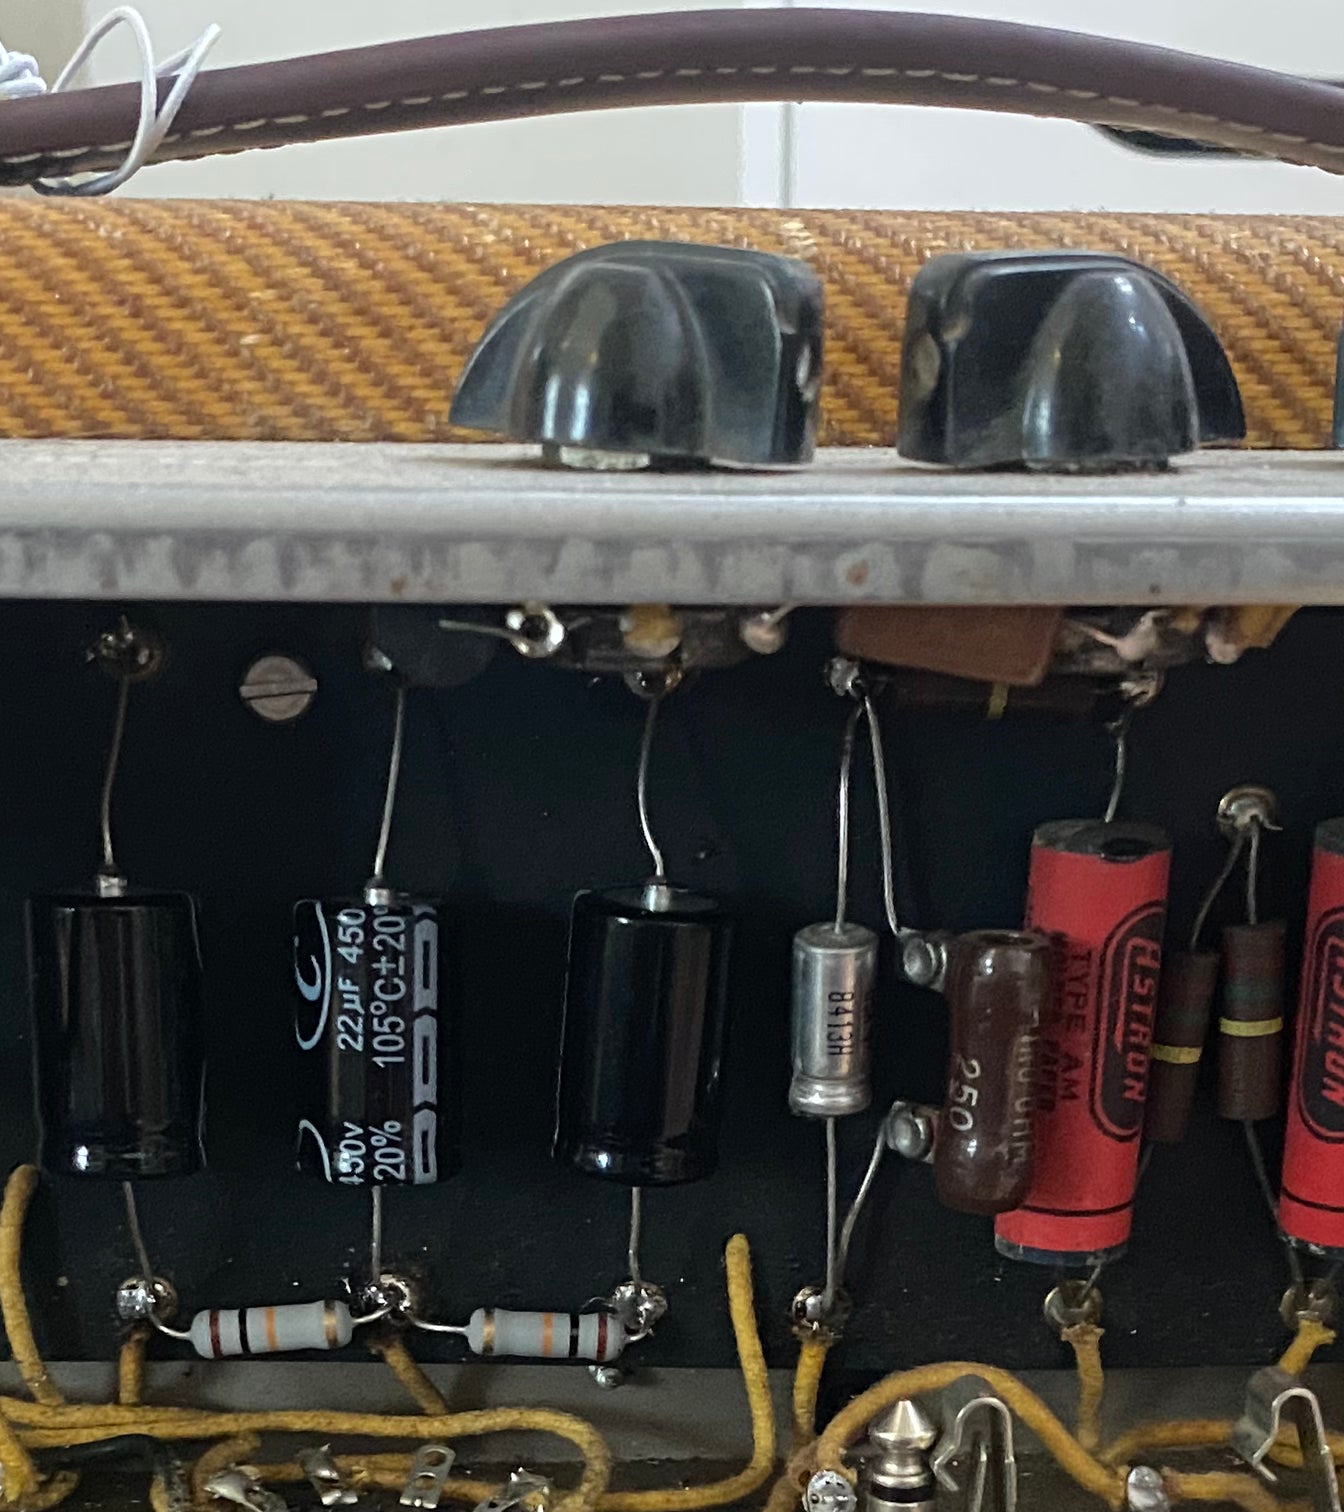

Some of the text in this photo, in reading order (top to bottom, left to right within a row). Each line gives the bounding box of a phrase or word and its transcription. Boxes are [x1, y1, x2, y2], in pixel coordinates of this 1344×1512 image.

[827, 991, 854, 1056] 8413H
[1060, 948, 1092, 1102] TYPE AM
[1114, 937, 1160, 1103] ASTRON
